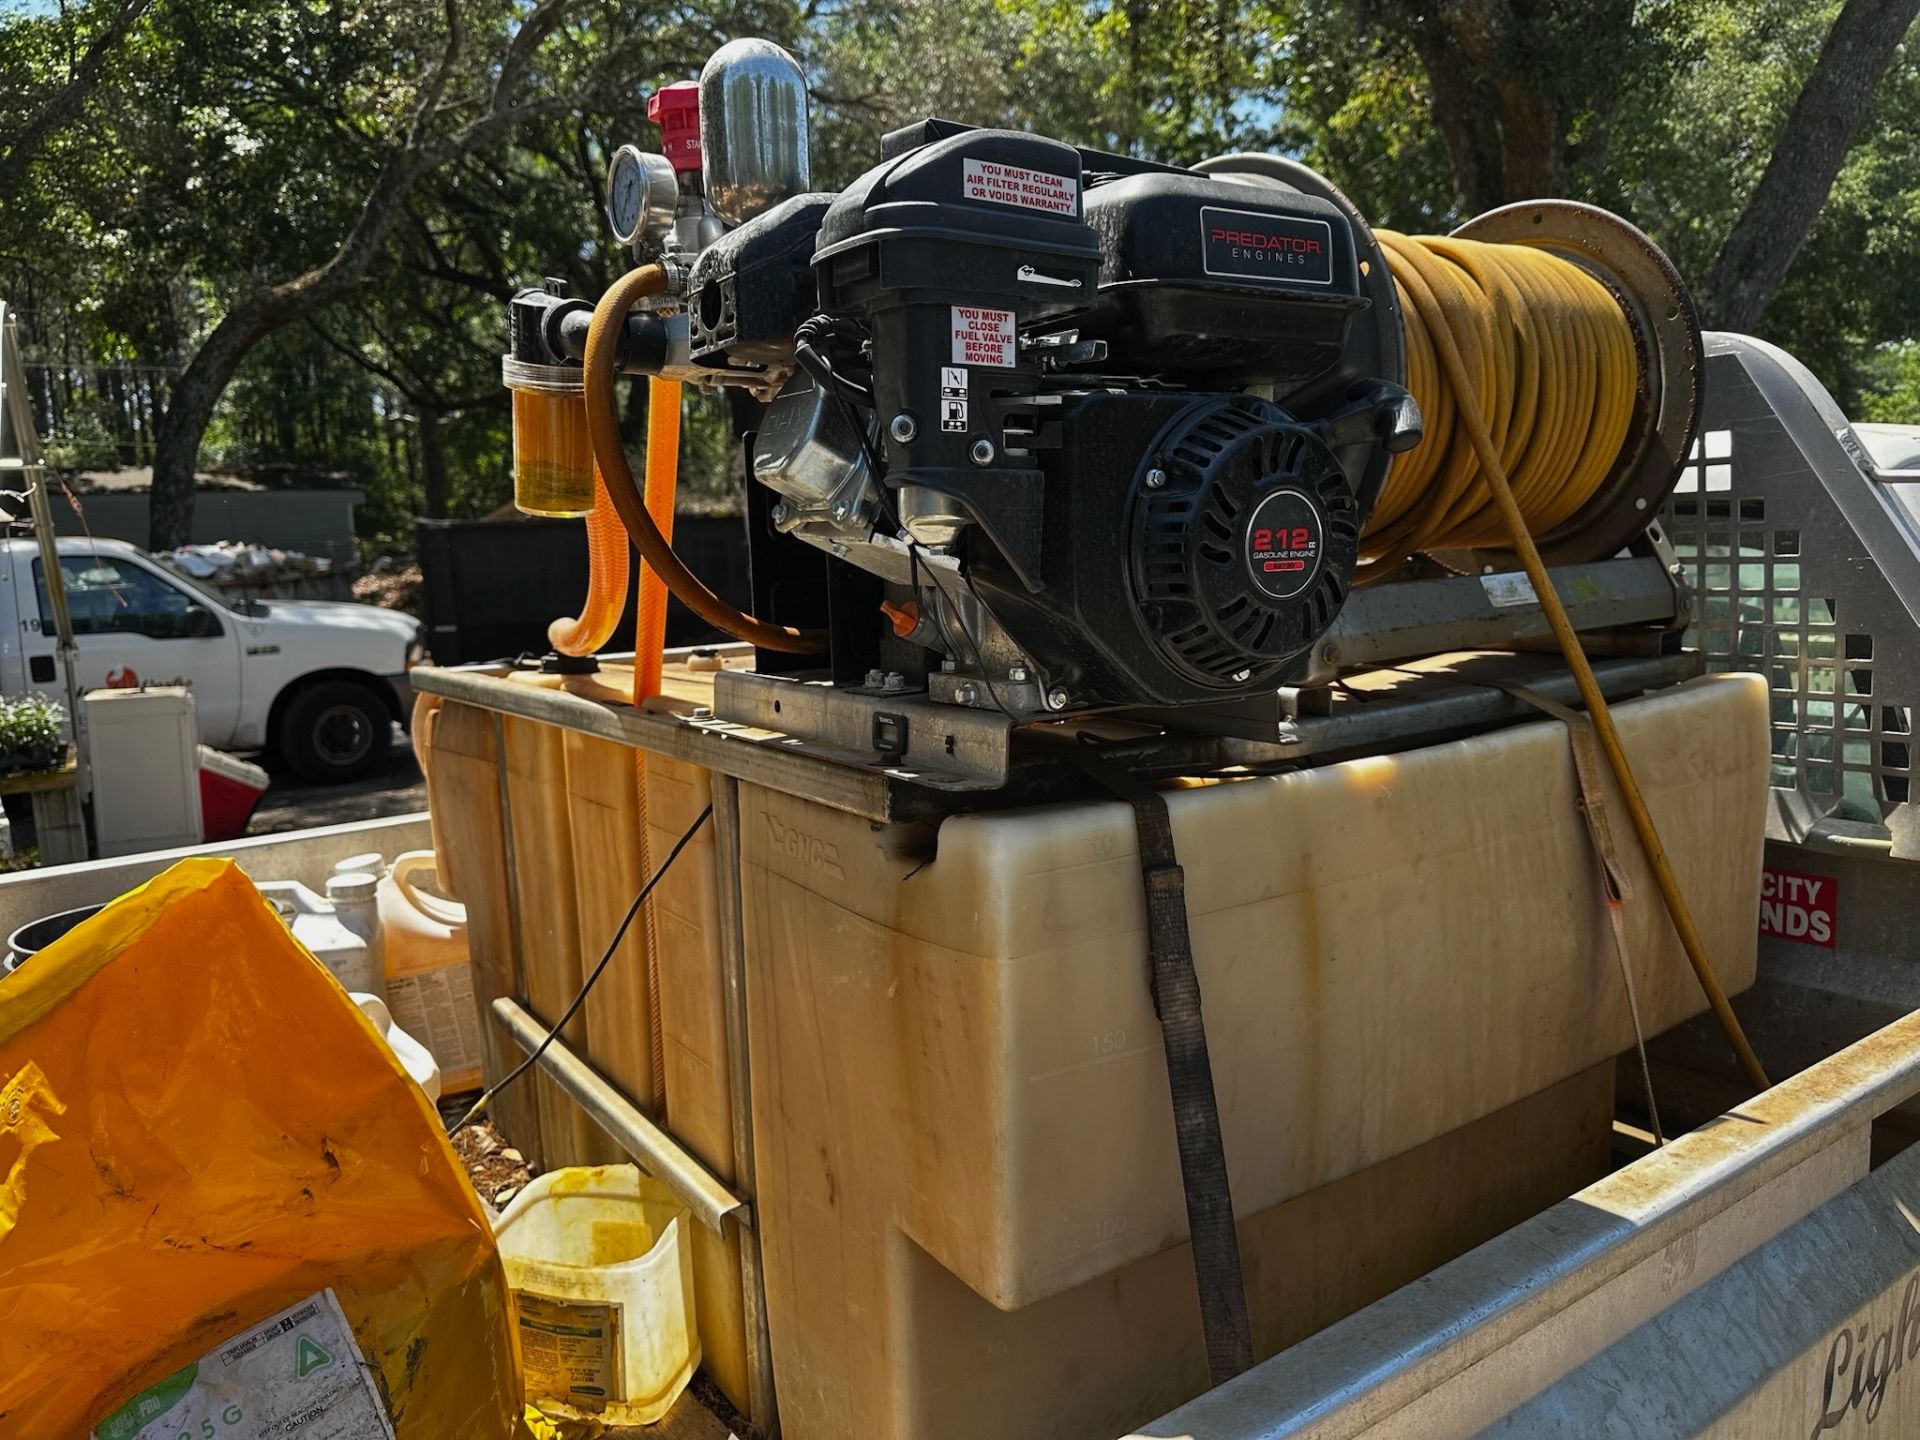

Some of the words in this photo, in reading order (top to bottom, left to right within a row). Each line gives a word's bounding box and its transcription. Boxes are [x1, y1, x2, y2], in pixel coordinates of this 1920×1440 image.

[980, 163, 1001, 176] YOU
[1004, 168, 1031, 181] MUST
[1033, 174, 1063, 188] CLEAN
[966, 174, 984, 185] AIR
[986, 177, 1020, 191] FILTER
[1022, 183, 1075, 201] REGULARLY
[971, 187, 986, 198] OR
[988, 190, 1018, 203] VOIDS
[1020, 195, 1071, 213] WARRANTY
[1211, 229, 1321, 254] PREDATOR
[1232, 248, 1305, 264] ENGINES
[958, 308, 979, 320] YOU
[981, 311, 1009, 323] MUST
[968, 321, 1000, 332] CLOSE
[955, 330, 980, 341] FUEL
[982, 333, 1013, 344] VALVE
[965, 342, 1003, 353] BEFORE
[965, 352, 1003, 364] MOVING
[1255, 529, 1308, 550] 212
[1253, 551, 1288, 559] GASOLINE
[1290, 550, 1315, 558] ENGINE
[1092, 1029, 1127, 1057] 150
[285, 1406, 324, 1432] CAUTION
